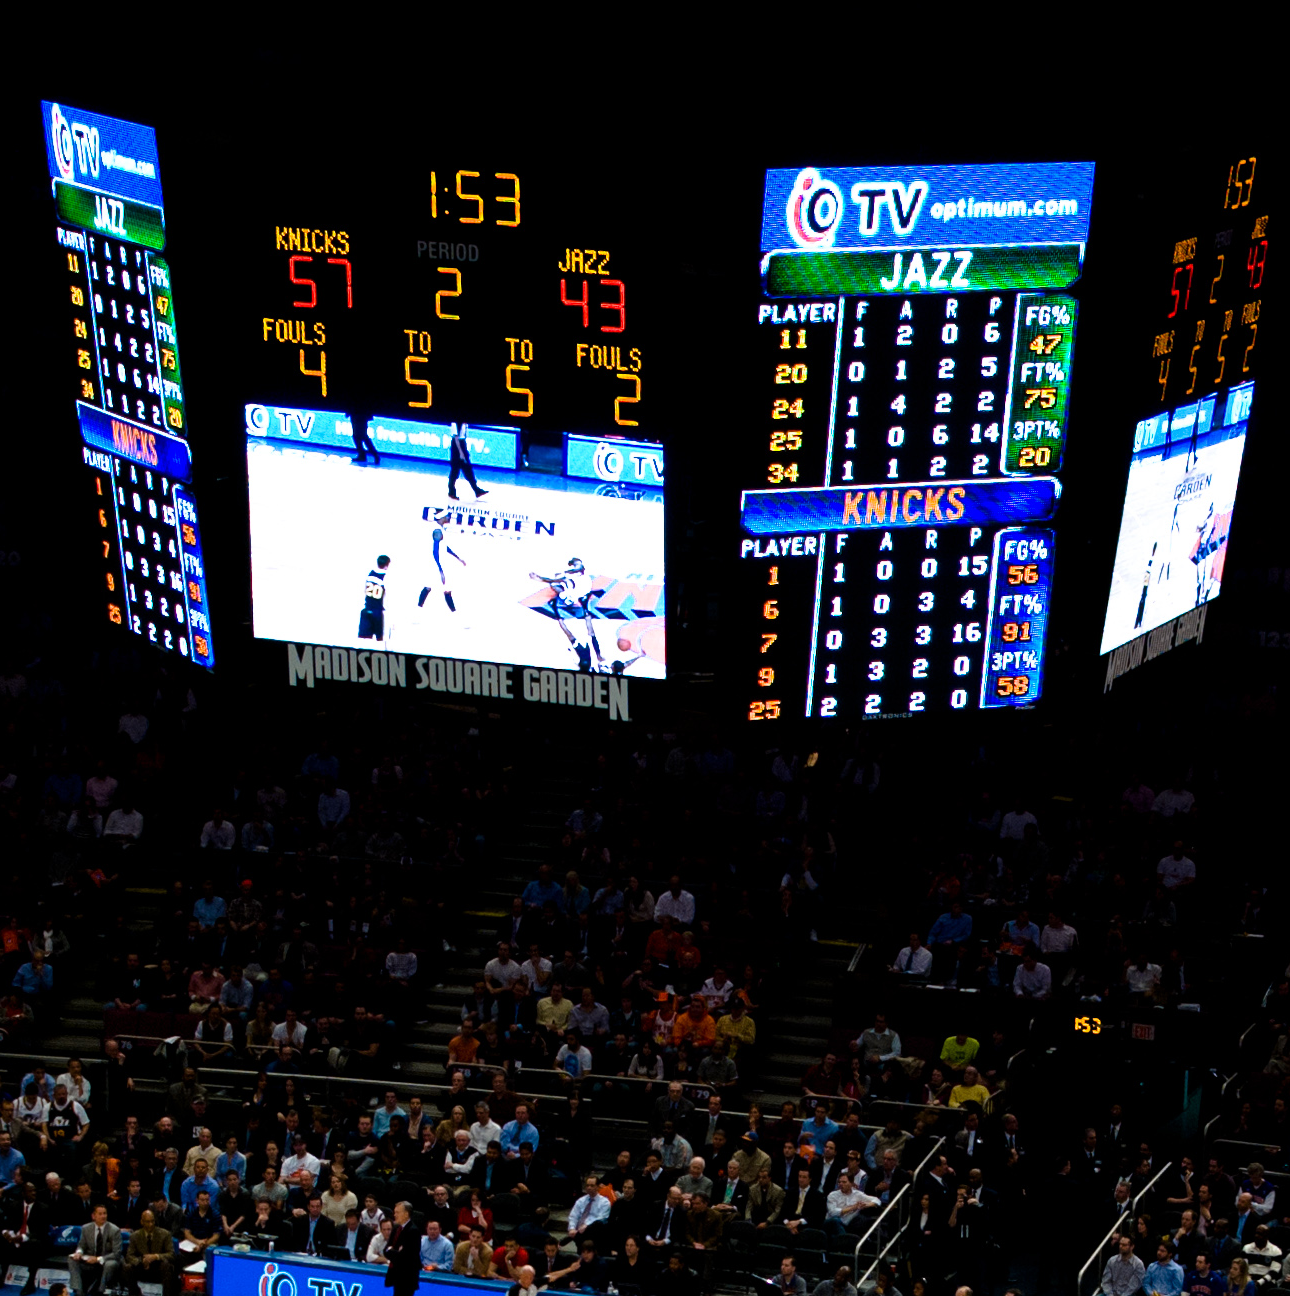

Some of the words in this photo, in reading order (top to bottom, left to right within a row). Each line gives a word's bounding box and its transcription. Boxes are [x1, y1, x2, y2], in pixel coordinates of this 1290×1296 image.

[430, 169, 521, 228] 1:53
[851, 181, 928, 235] TV
[931, 197, 1078, 222] optimum.com
[94, 195, 127, 236] JAZZ
[275, 226, 350, 255] KNICKS
[416, 241, 480, 262] PERIOD
[558, 248, 611, 276] JAZZ
[879, 250, 974, 290] JAZZ
[289, 255, 353, 309] 57
[435, 266, 463, 321] 2
[1167, 263, 1194, 319] 57
[560, 278, 626, 333] 43
[759, 302, 836, 324] PLAYER
[855, 300, 869, 319] F
[899, 300, 912, 320] A
[945, 299, 959, 319] R
[989, 297, 1002, 315] P
[1025, 304, 1071, 327] FG%
[262, 317, 326, 346] FOULS
[403, 329, 432, 354] TO
[779, 328, 808, 350] 11
[853, 326, 865, 348] 1
[896, 324, 913, 346] 2
[941, 323, 959, 344] 0
[984, 322, 1001, 343] 6
[1029, 334, 1062, 355] 47
[504, 337, 534, 363] TO
[576, 343, 642, 373] FOULS
[299, 348, 327, 397] 4
[404, 355, 432, 409] 5
[773, 363, 808, 385] 20
[847, 361, 865, 382] 0
[895, 359, 907, 380] 1
[938, 358, 956, 379] 2
[980, 356, 998, 377] 5
[1020, 361, 1065, 383] FT%
[505, 363, 534, 418] 5
[613, 373, 642, 427] 2
[1024, 388, 1057, 409] 75
[769, 429, 803, 452] 25
[844, 427, 856, 449] 1
[886, 425, 905, 447] 0
[932, 424, 949, 445] 6
[970, 422, 1000, 444] 14
[1012, 420, 1060, 441] 3PT%
[1018, 447, 1051, 468] 20
[841, 487, 967, 525] KNICKS
[740, 537, 817, 558] PLAYER
[836, 533, 849, 554] F
[879, 531, 893, 551] A
[925, 529, 938, 549] R
[969, 527, 982, 547] P
[1004, 539, 1049, 561] FG%
[767, 565, 779, 586] 1
[833, 562, 845, 583] 1
[876, 559, 893, 580] 0
[920, 557, 938, 578] 0
[958, 555, 988, 576] 15
[1007, 564, 1039, 585] 56
[999, 593, 1044, 616] FT%
[760, 633, 778, 654] 7
[825, 629, 843, 650] 0
[870, 627, 887, 648] 3
[914, 625, 932, 645] 3
[952, 621, 982, 643] 16
[1002, 621, 1031, 642] 91
[991, 650, 1039, 672] 3PT%
[286, 643, 407, 689] MADISON
[415, 656, 514, 699] SQUARE
[522, 667, 631, 722] GARDEN
[997, 675, 1029, 696] 58
[748, 699, 781, 721] 25
[820, 696, 838, 717] 2
[864, 693, 881, 714] 2
[908, 691, 926, 711] 2
[950, 689, 967, 709] 0
[1074, 1016, 1102, 1035] 1:53
